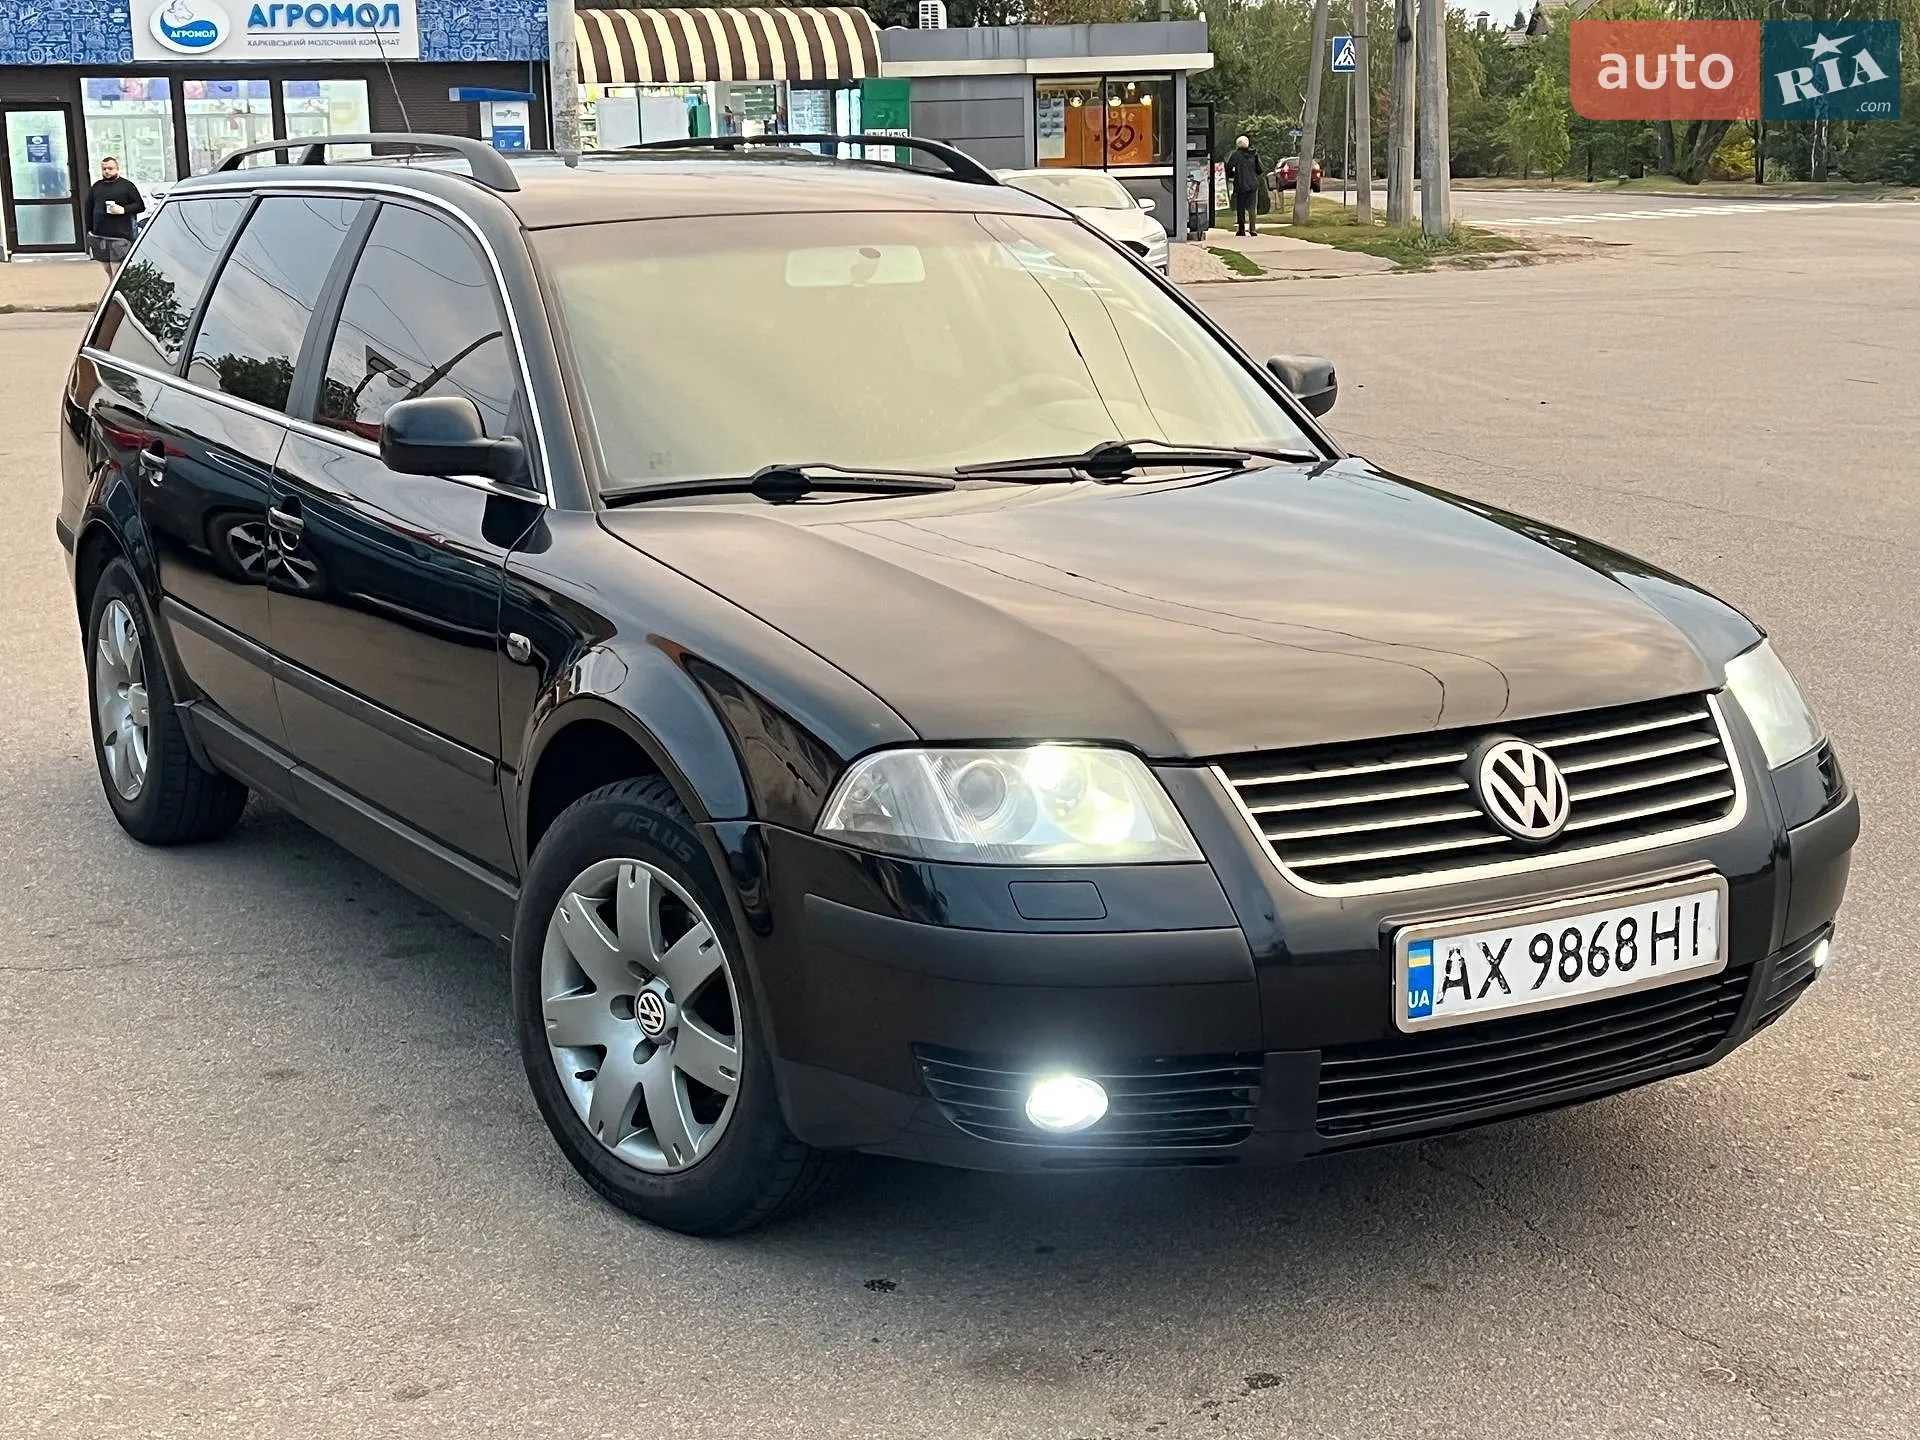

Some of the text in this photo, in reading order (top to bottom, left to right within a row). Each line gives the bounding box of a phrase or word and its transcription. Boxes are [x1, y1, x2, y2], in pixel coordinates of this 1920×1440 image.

[247, 3, 400, 28] АГРОМОЛ
[170, 30, 217, 38] АГРОМОЛ
[1528, 916, 1638, 991] 9868
[1650, 901, 1701, 967] HI
[1408, 988, 1430, 1009] UA
